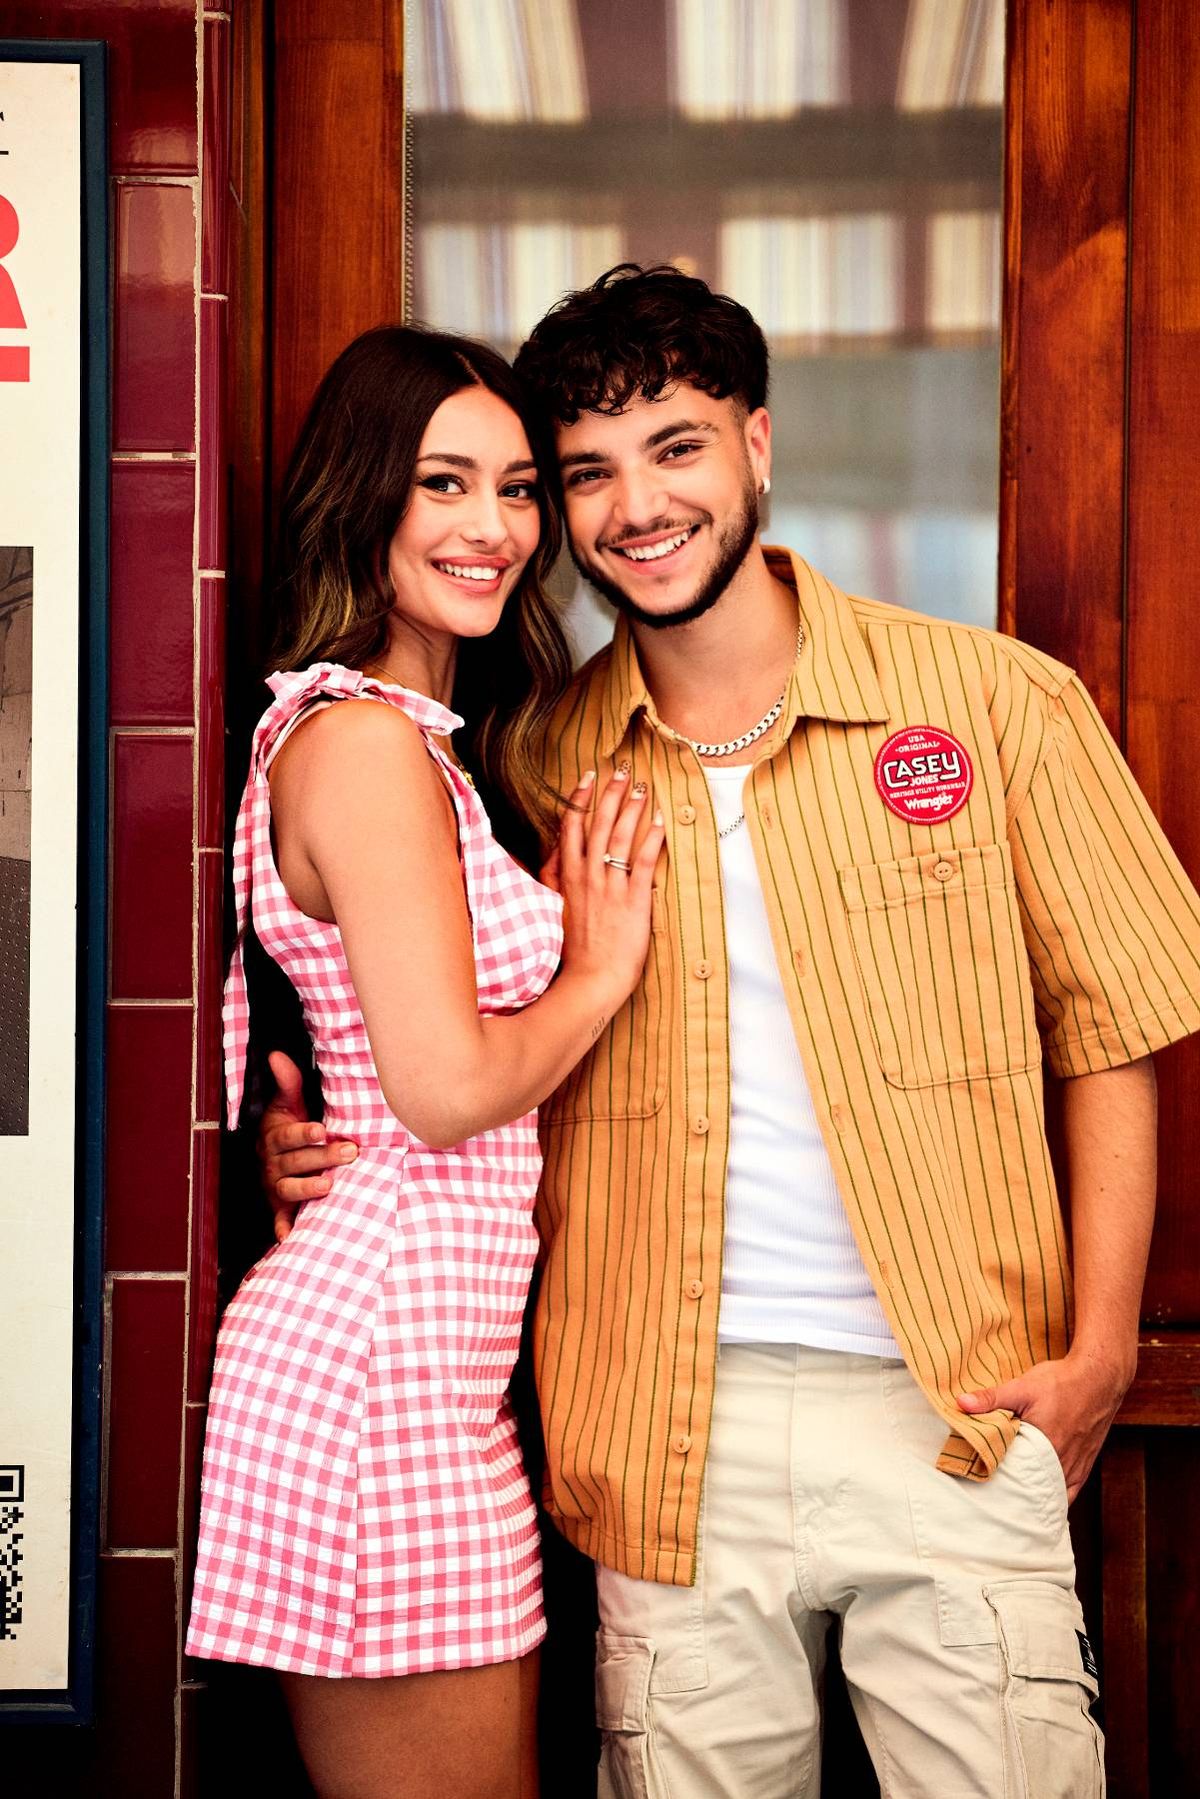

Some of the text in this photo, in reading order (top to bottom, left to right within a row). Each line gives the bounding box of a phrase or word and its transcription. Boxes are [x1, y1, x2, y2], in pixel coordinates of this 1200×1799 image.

[883, 751, 961, 788] CASEY
[910, 774, 939, 787] JONES
[904, 793, 953, 811] Wrangler
